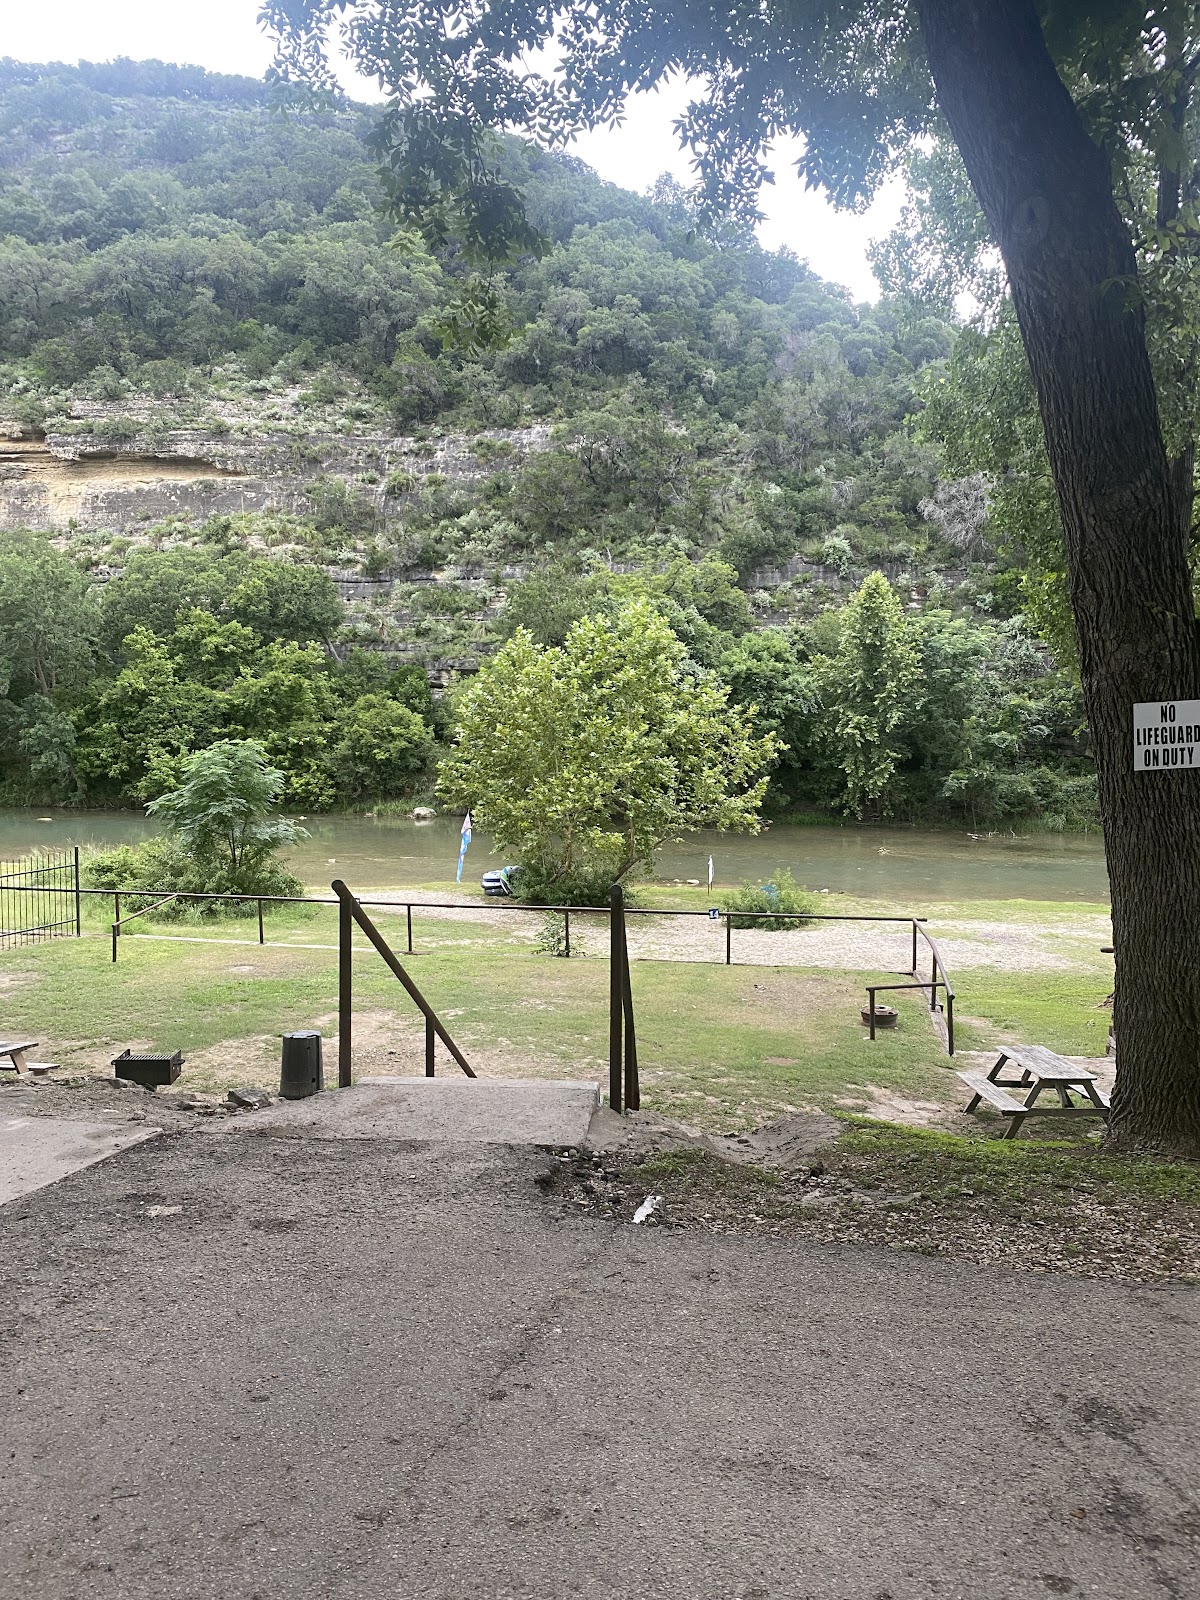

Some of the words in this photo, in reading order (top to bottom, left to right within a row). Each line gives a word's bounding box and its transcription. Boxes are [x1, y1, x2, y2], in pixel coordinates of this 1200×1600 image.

[1161, 705, 1176, 723] NO
[1136, 725, 1200, 746] LIFEGUARD
[1144, 748, 1159, 767] ON
[1163, 747, 1194, 766] DUTY
